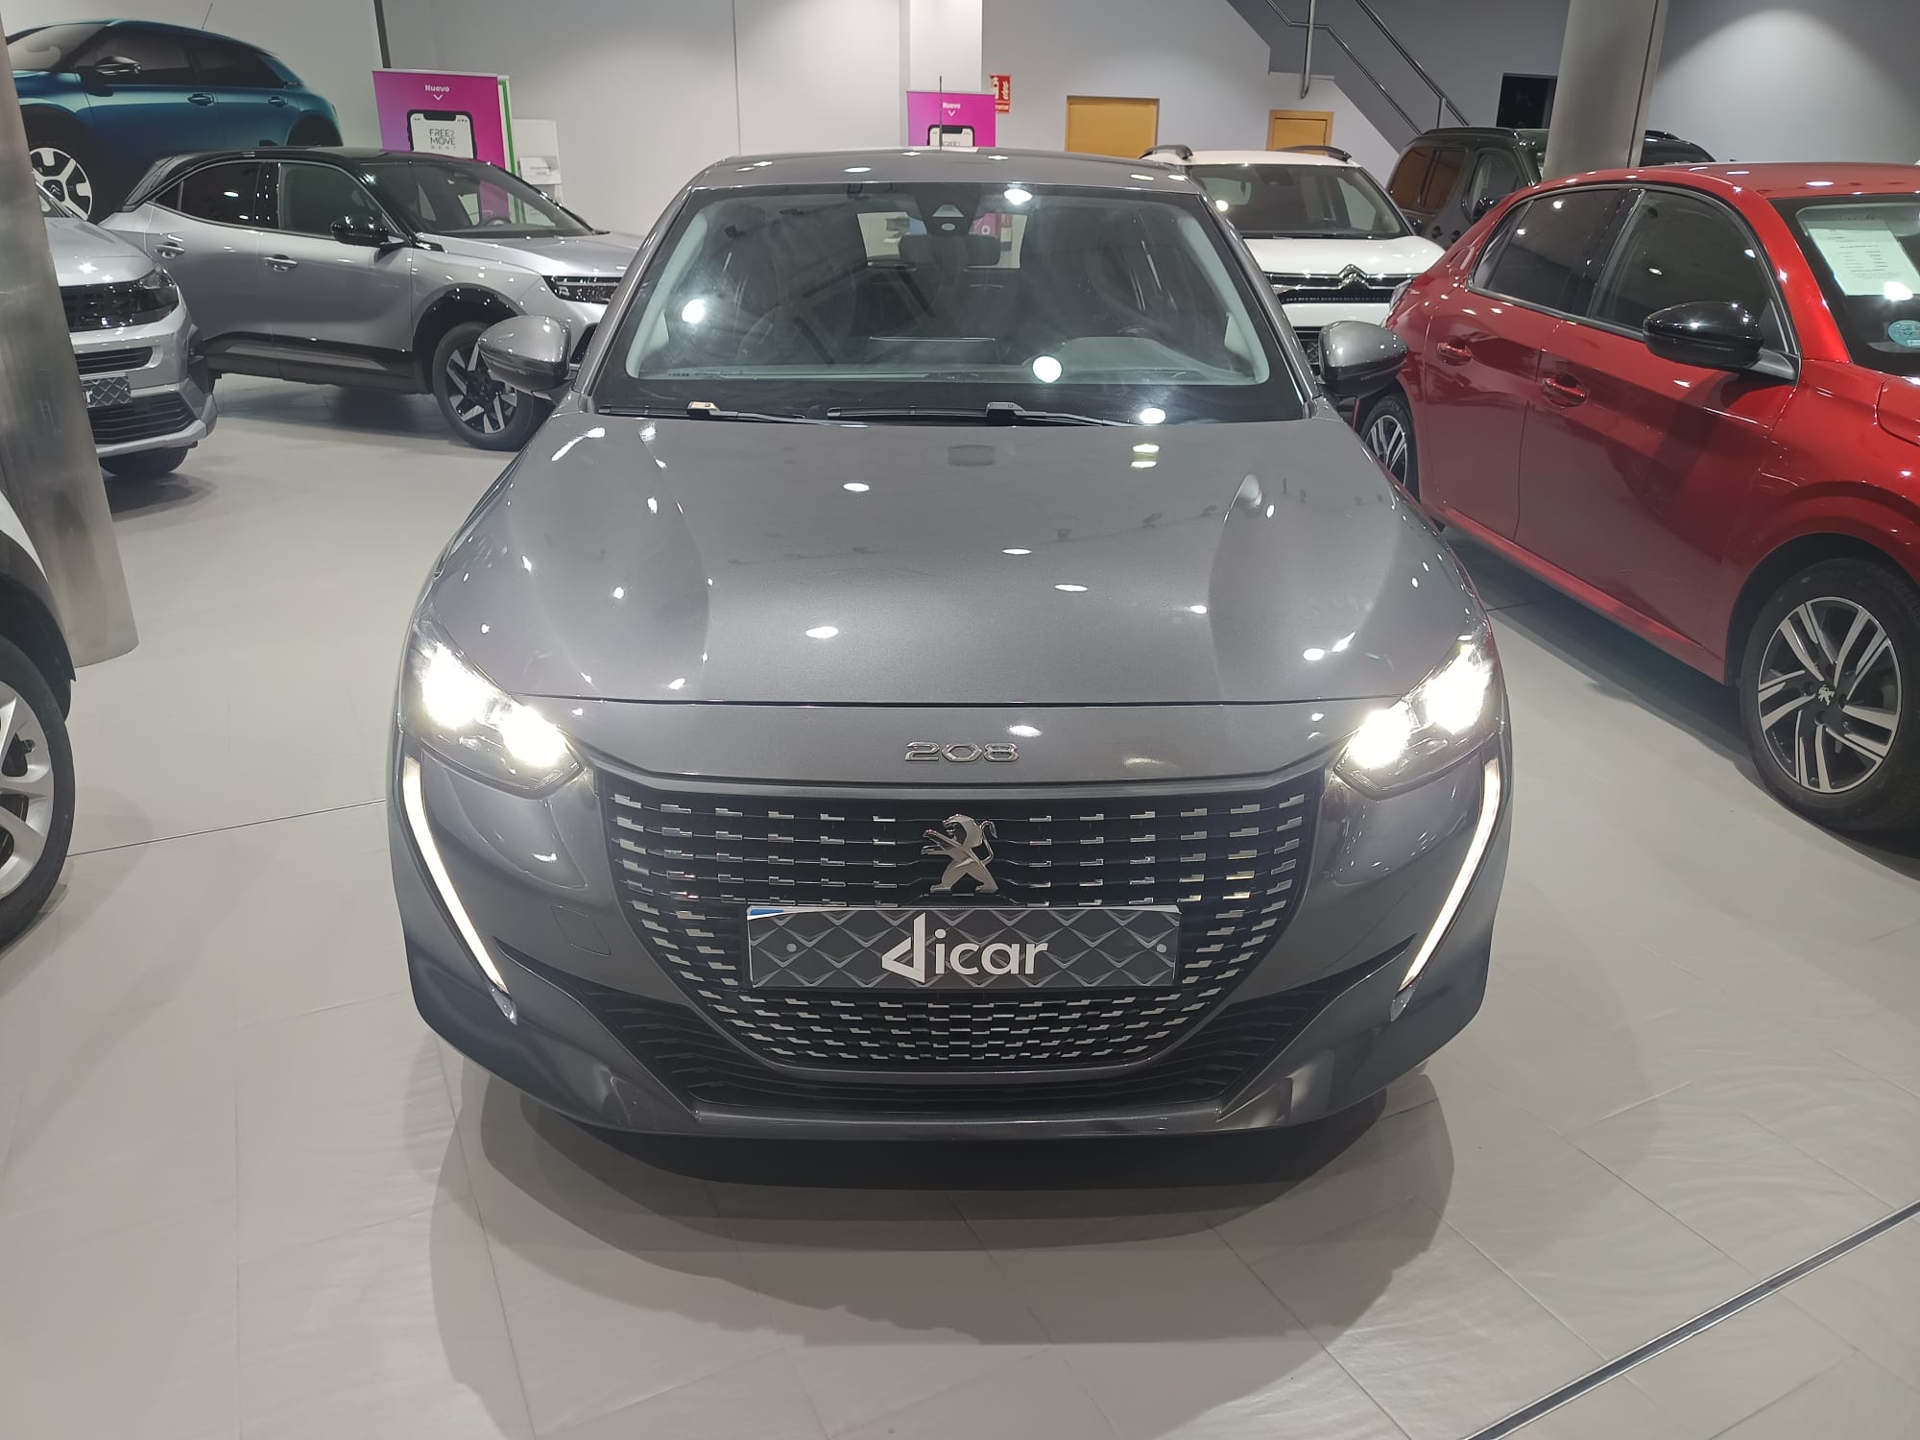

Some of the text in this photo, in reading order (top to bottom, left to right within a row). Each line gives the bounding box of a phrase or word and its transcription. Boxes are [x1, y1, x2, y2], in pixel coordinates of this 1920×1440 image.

[425, 84, 450, 92] Nuevo
[429, 128, 455, 138] FREE2
[430, 137, 456, 146] MOVE
[904, 741, 1020, 763] 208
[881, 912, 1048, 984] dicar
